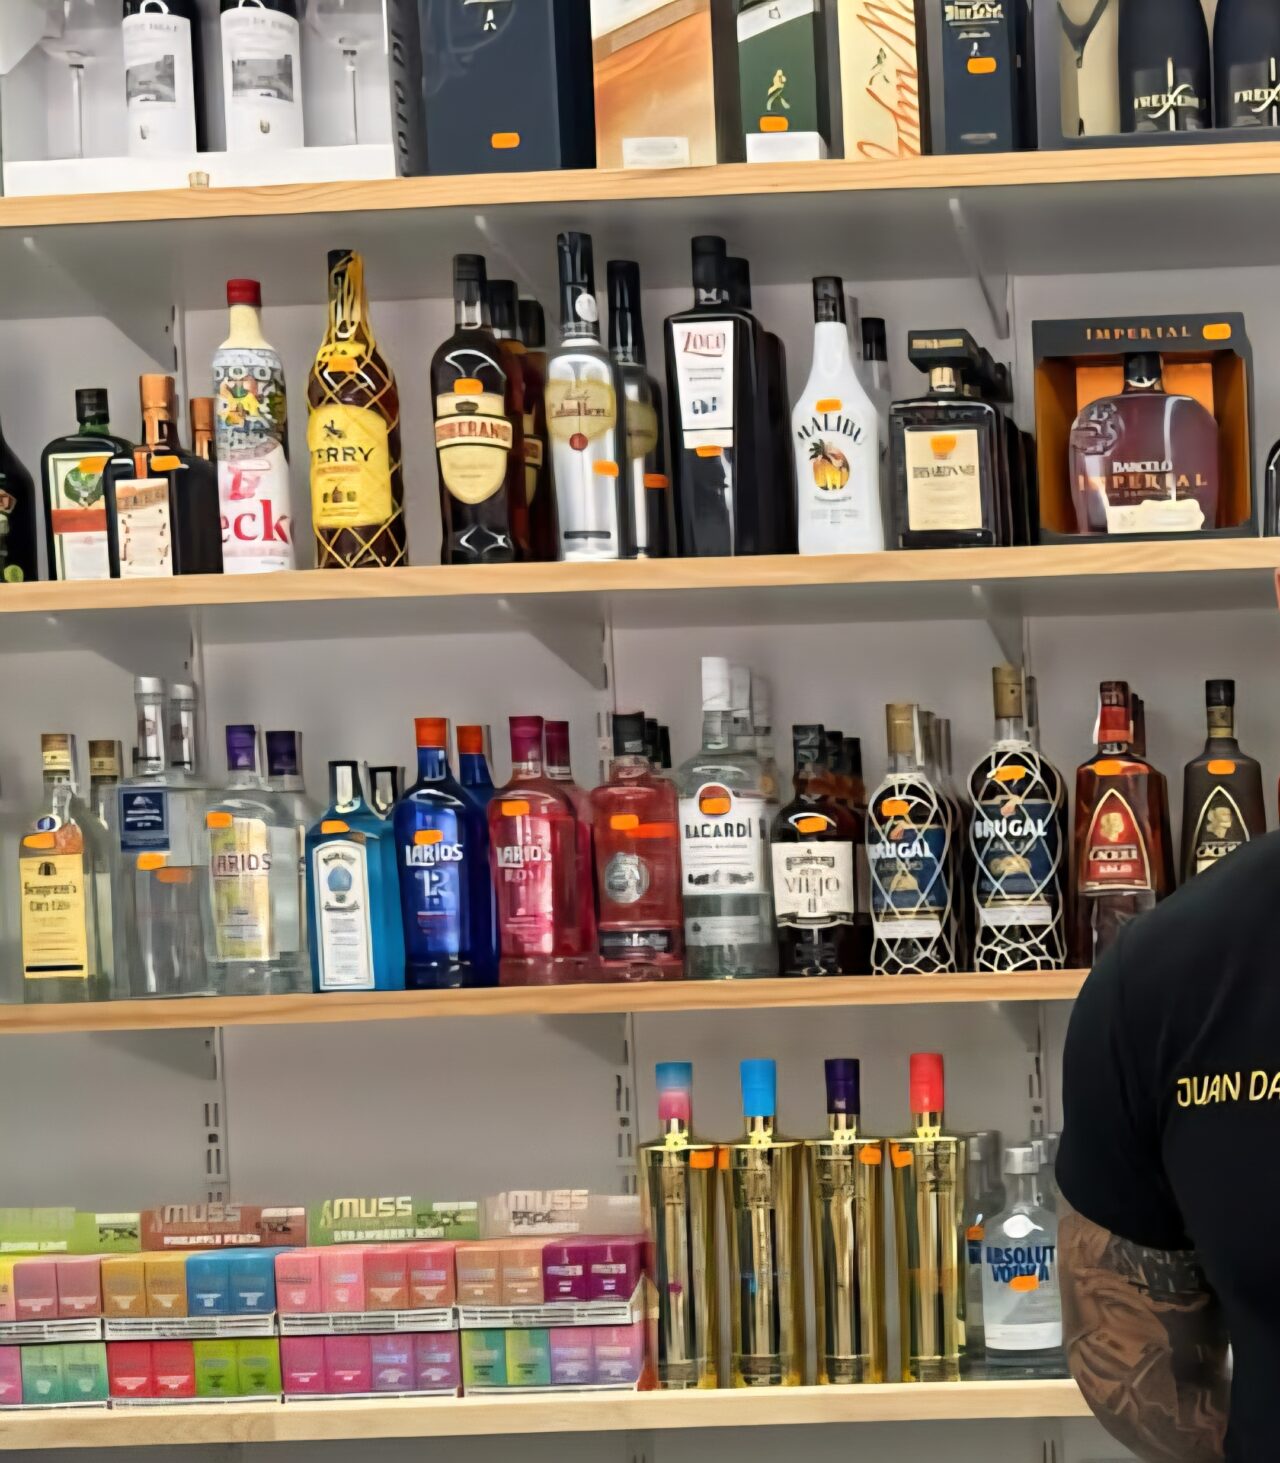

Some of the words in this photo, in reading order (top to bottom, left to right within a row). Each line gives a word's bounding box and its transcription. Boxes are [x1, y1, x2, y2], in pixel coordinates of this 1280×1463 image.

[1085, 325, 1193, 341] IMPERIAL
[405, 844, 464, 867] LARIOS
[1176, 1071, 1242, 1107] JUAN
[986, 1245, 1056, 1266] ABSOLUT
